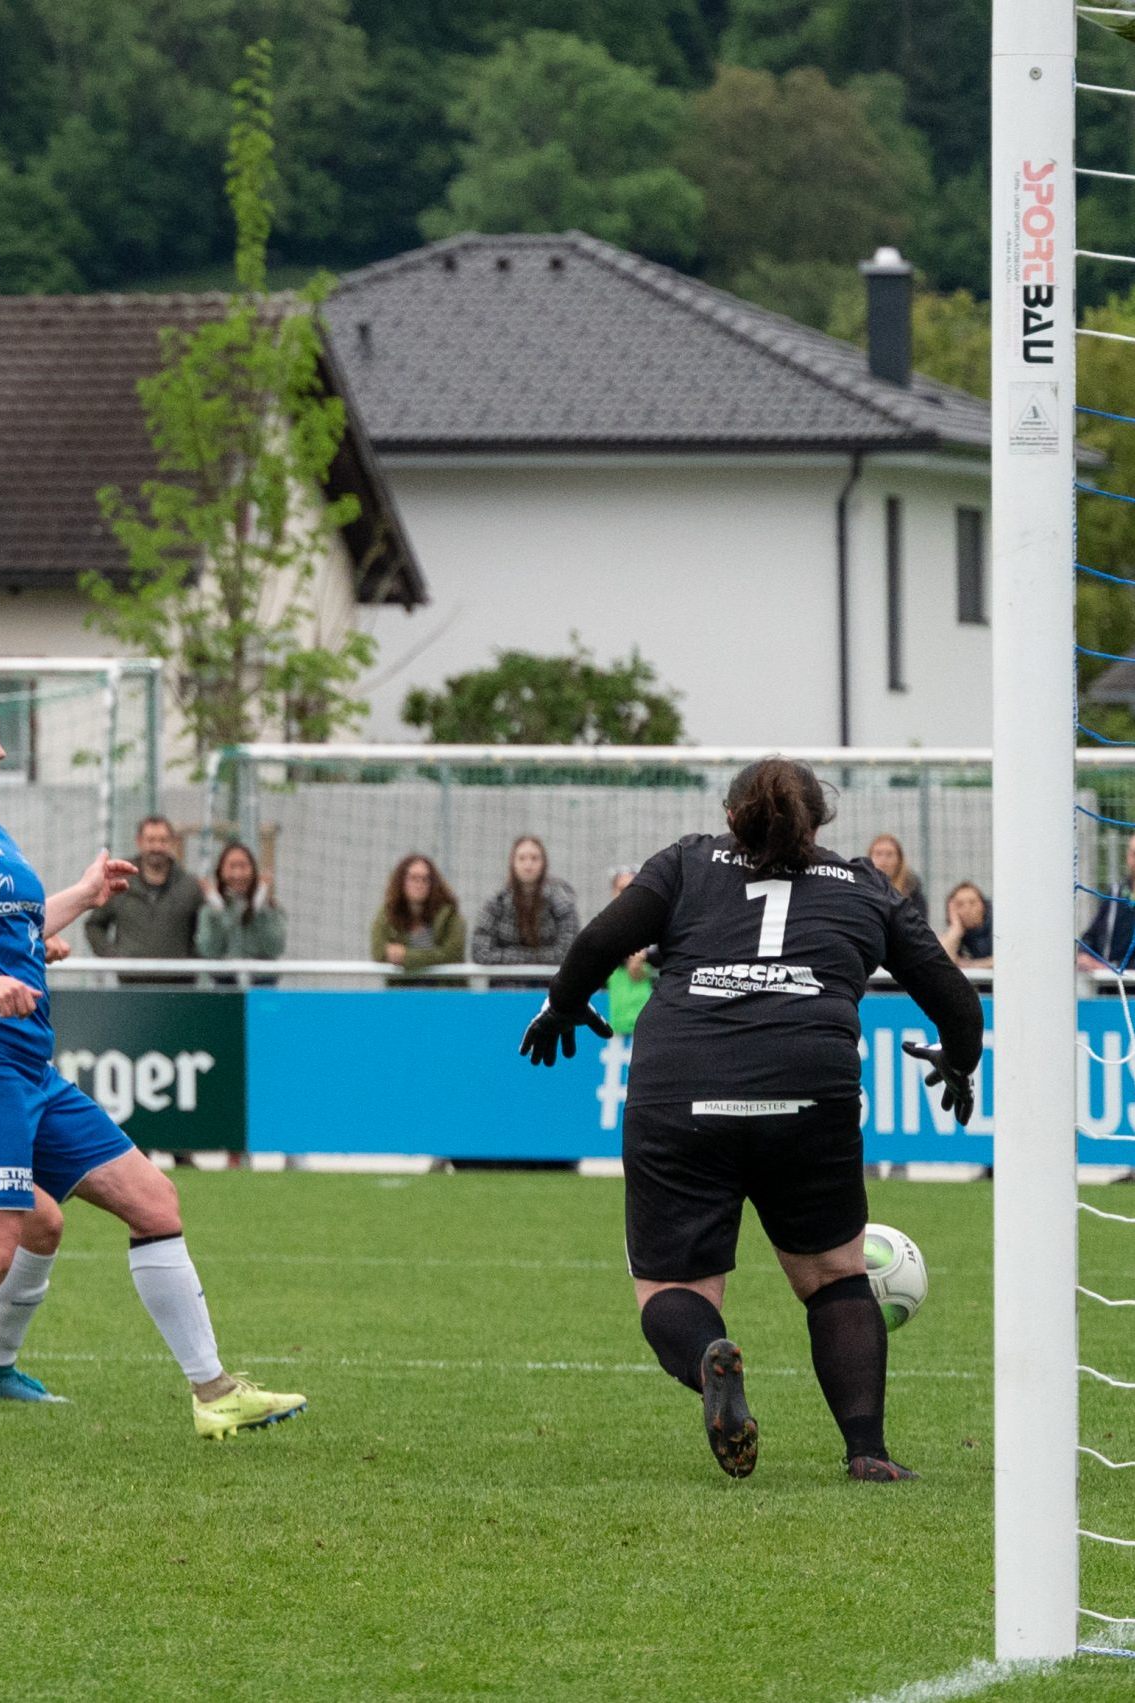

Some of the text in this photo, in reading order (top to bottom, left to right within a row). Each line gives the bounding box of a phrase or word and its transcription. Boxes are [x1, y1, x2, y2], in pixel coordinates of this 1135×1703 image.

[712, 850, 731, 865] FC
[745, 879, 793, 957] 1
[704, 1101, 787, 1113] MALERMEISTER
